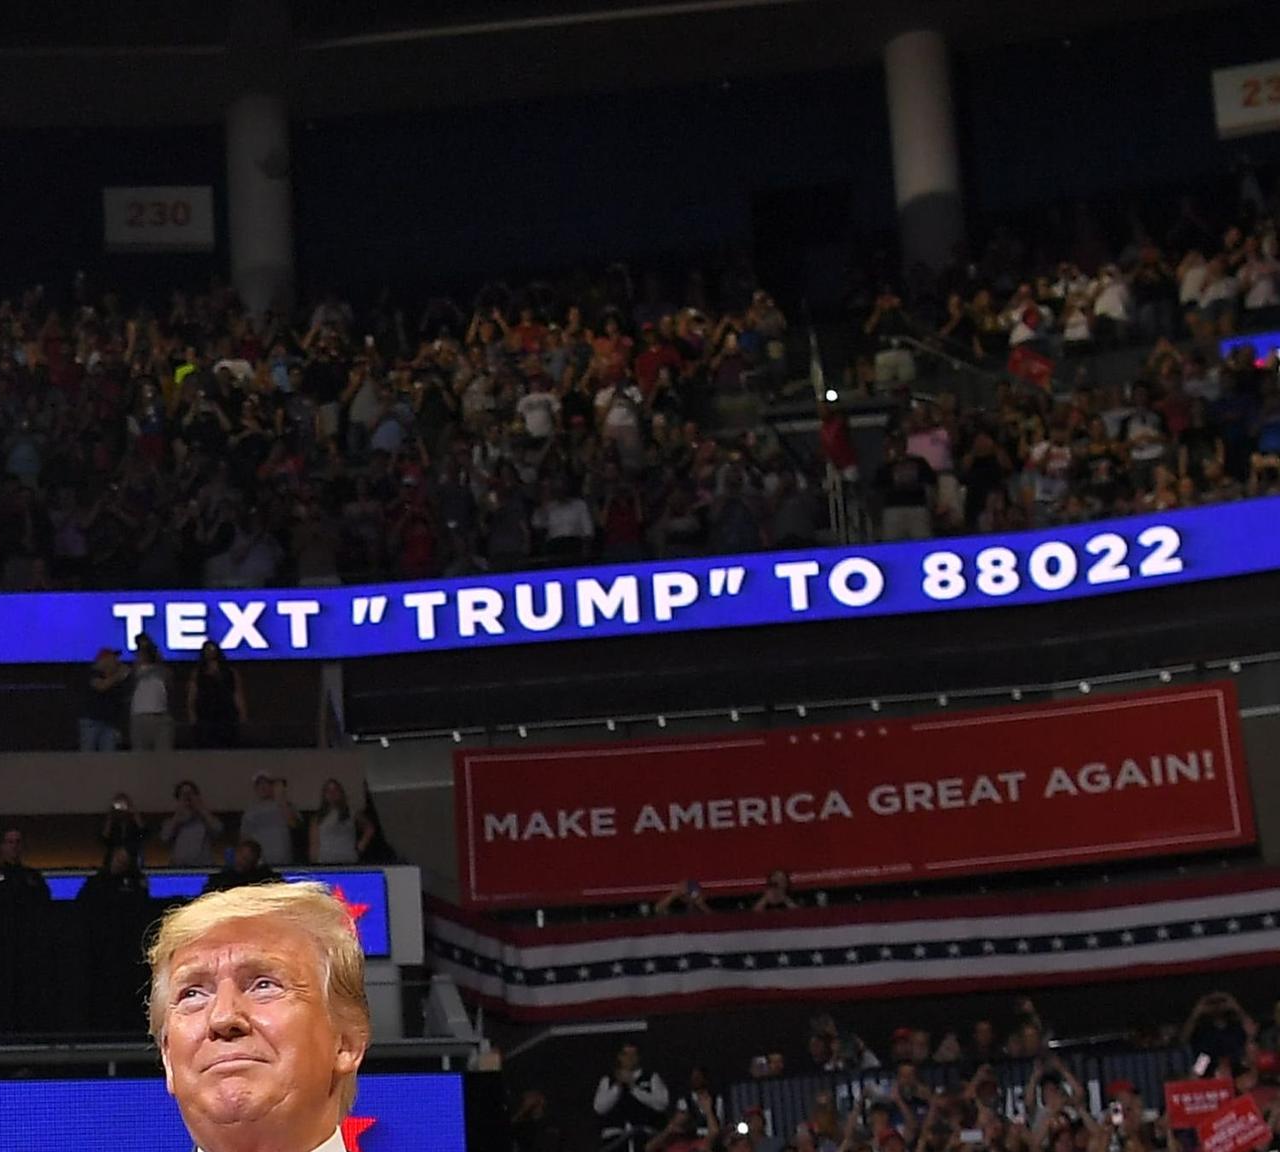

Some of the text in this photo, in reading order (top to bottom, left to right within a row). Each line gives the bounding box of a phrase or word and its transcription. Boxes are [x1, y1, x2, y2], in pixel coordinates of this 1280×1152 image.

[126, 201, 191, 227] 230
[112, 525, 1183, 651] TEXT "TRUMP" TO 88022
[485, 750, 1215, 841] MAKE AMERICA GREAT AGAIN!
